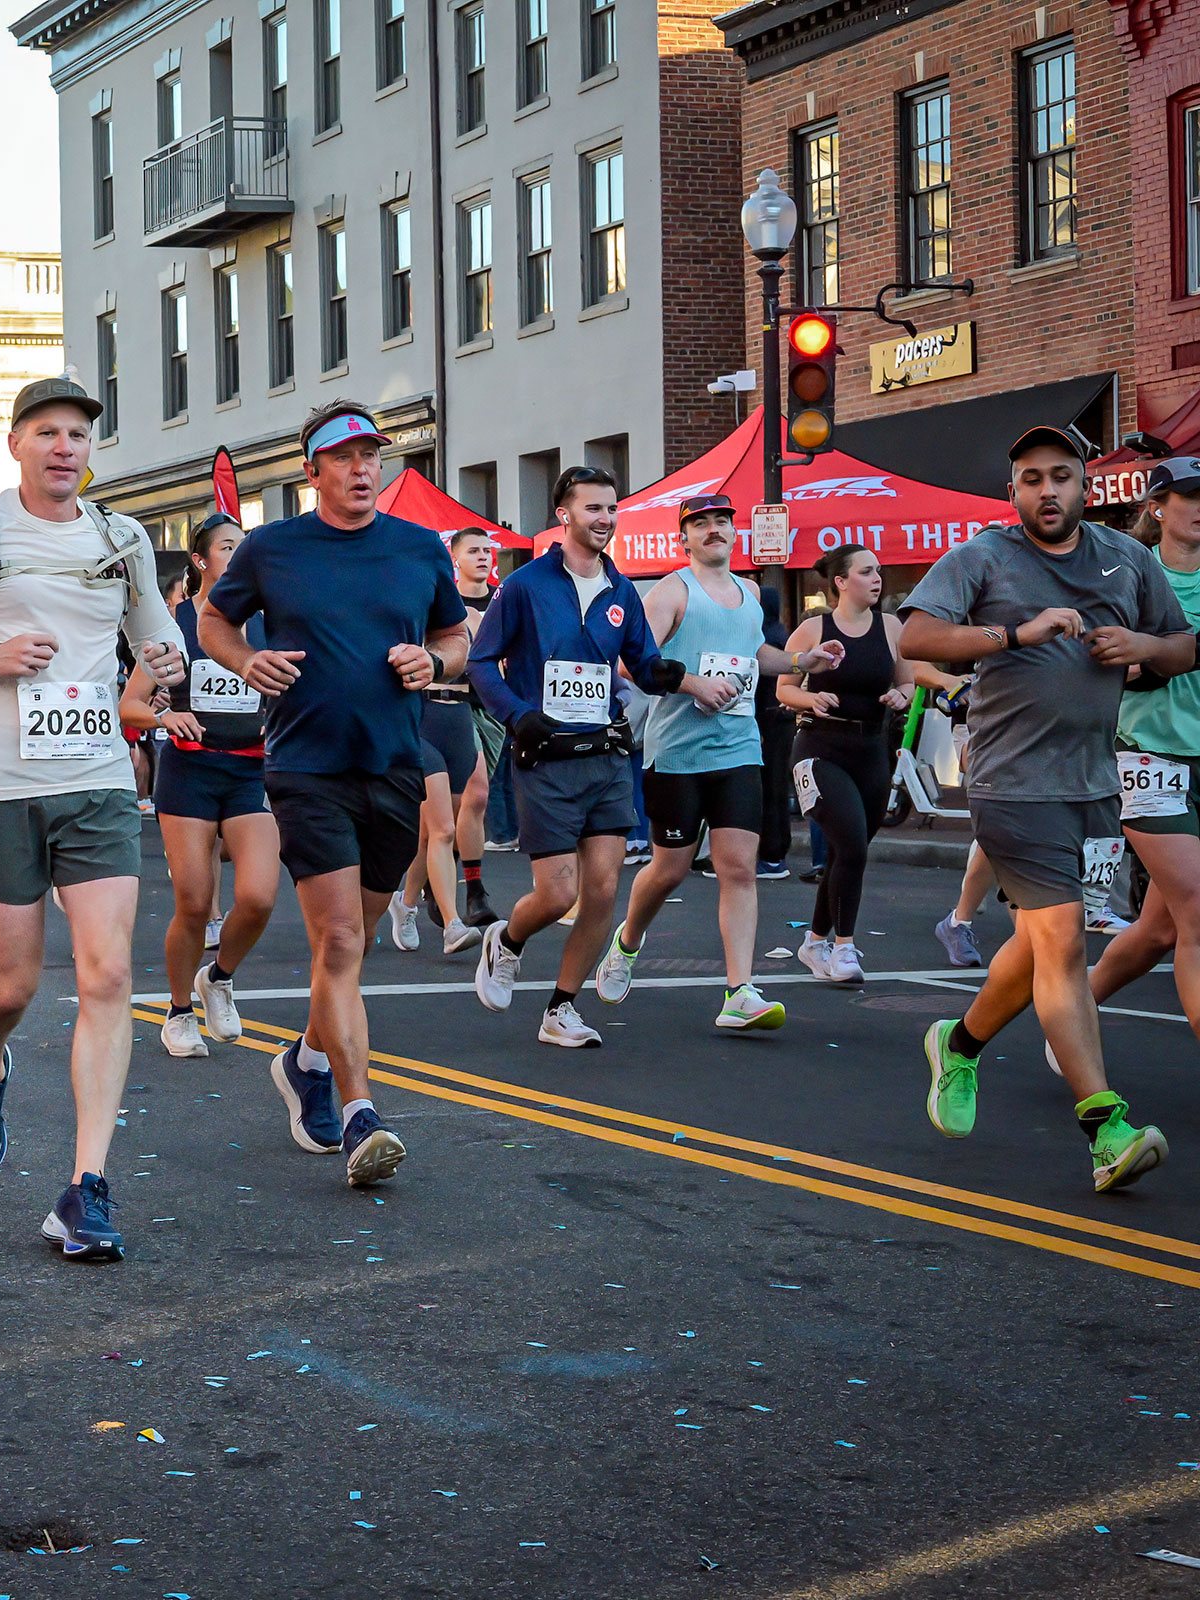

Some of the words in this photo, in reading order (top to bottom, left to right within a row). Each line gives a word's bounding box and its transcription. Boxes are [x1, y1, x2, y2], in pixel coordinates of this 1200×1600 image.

[895, 334, 944, 369] pacers
[817, 525, 884, 553] OUT
[200, 677, 249, 696] 4231
[548, 679, 606, 700] 12980
[27, 709, 112, 736] 20268
